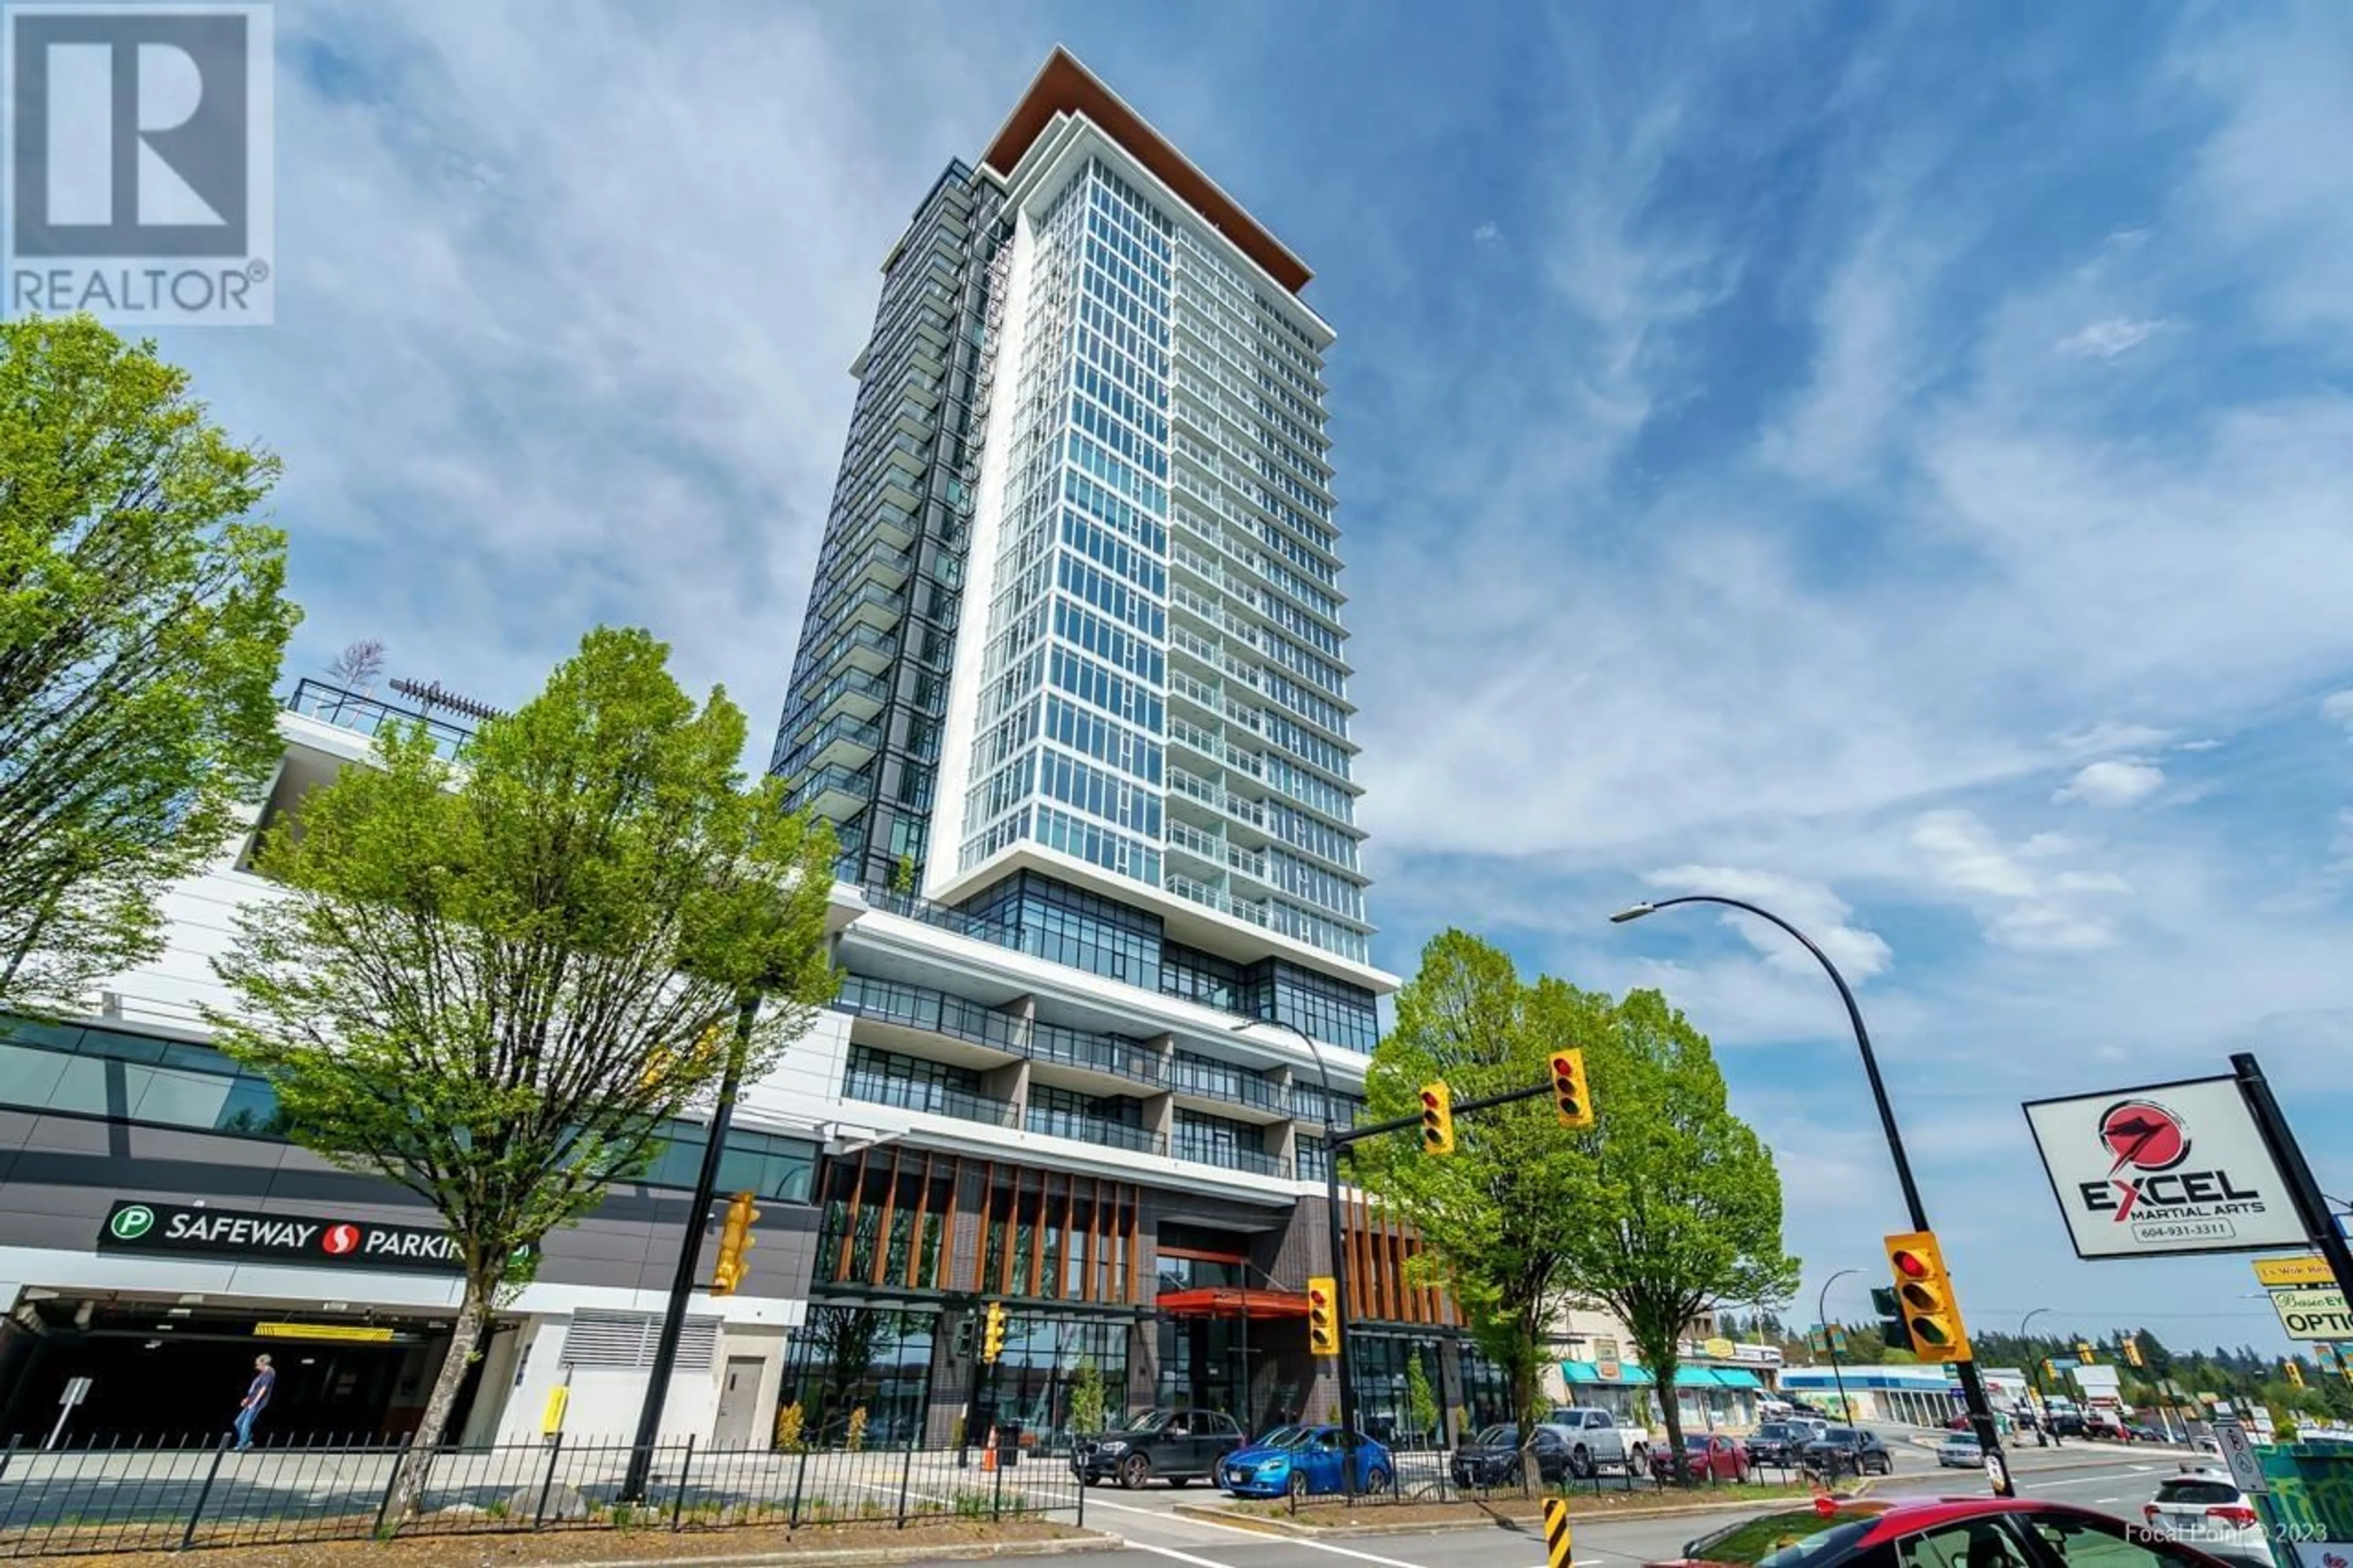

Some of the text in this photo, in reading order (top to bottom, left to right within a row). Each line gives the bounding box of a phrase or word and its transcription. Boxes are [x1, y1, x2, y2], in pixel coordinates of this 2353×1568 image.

[2079, 1170, 2260, 1222] EXCEL
[2130, 1202, 2267, 1221] MARTIAL ARTS
[165, 1214, 317, 1248] SAFEWAY
[365, 1230, 466, 1260] PARKIN
[2141, 1223, 2226, 1238] 604-931-3311
